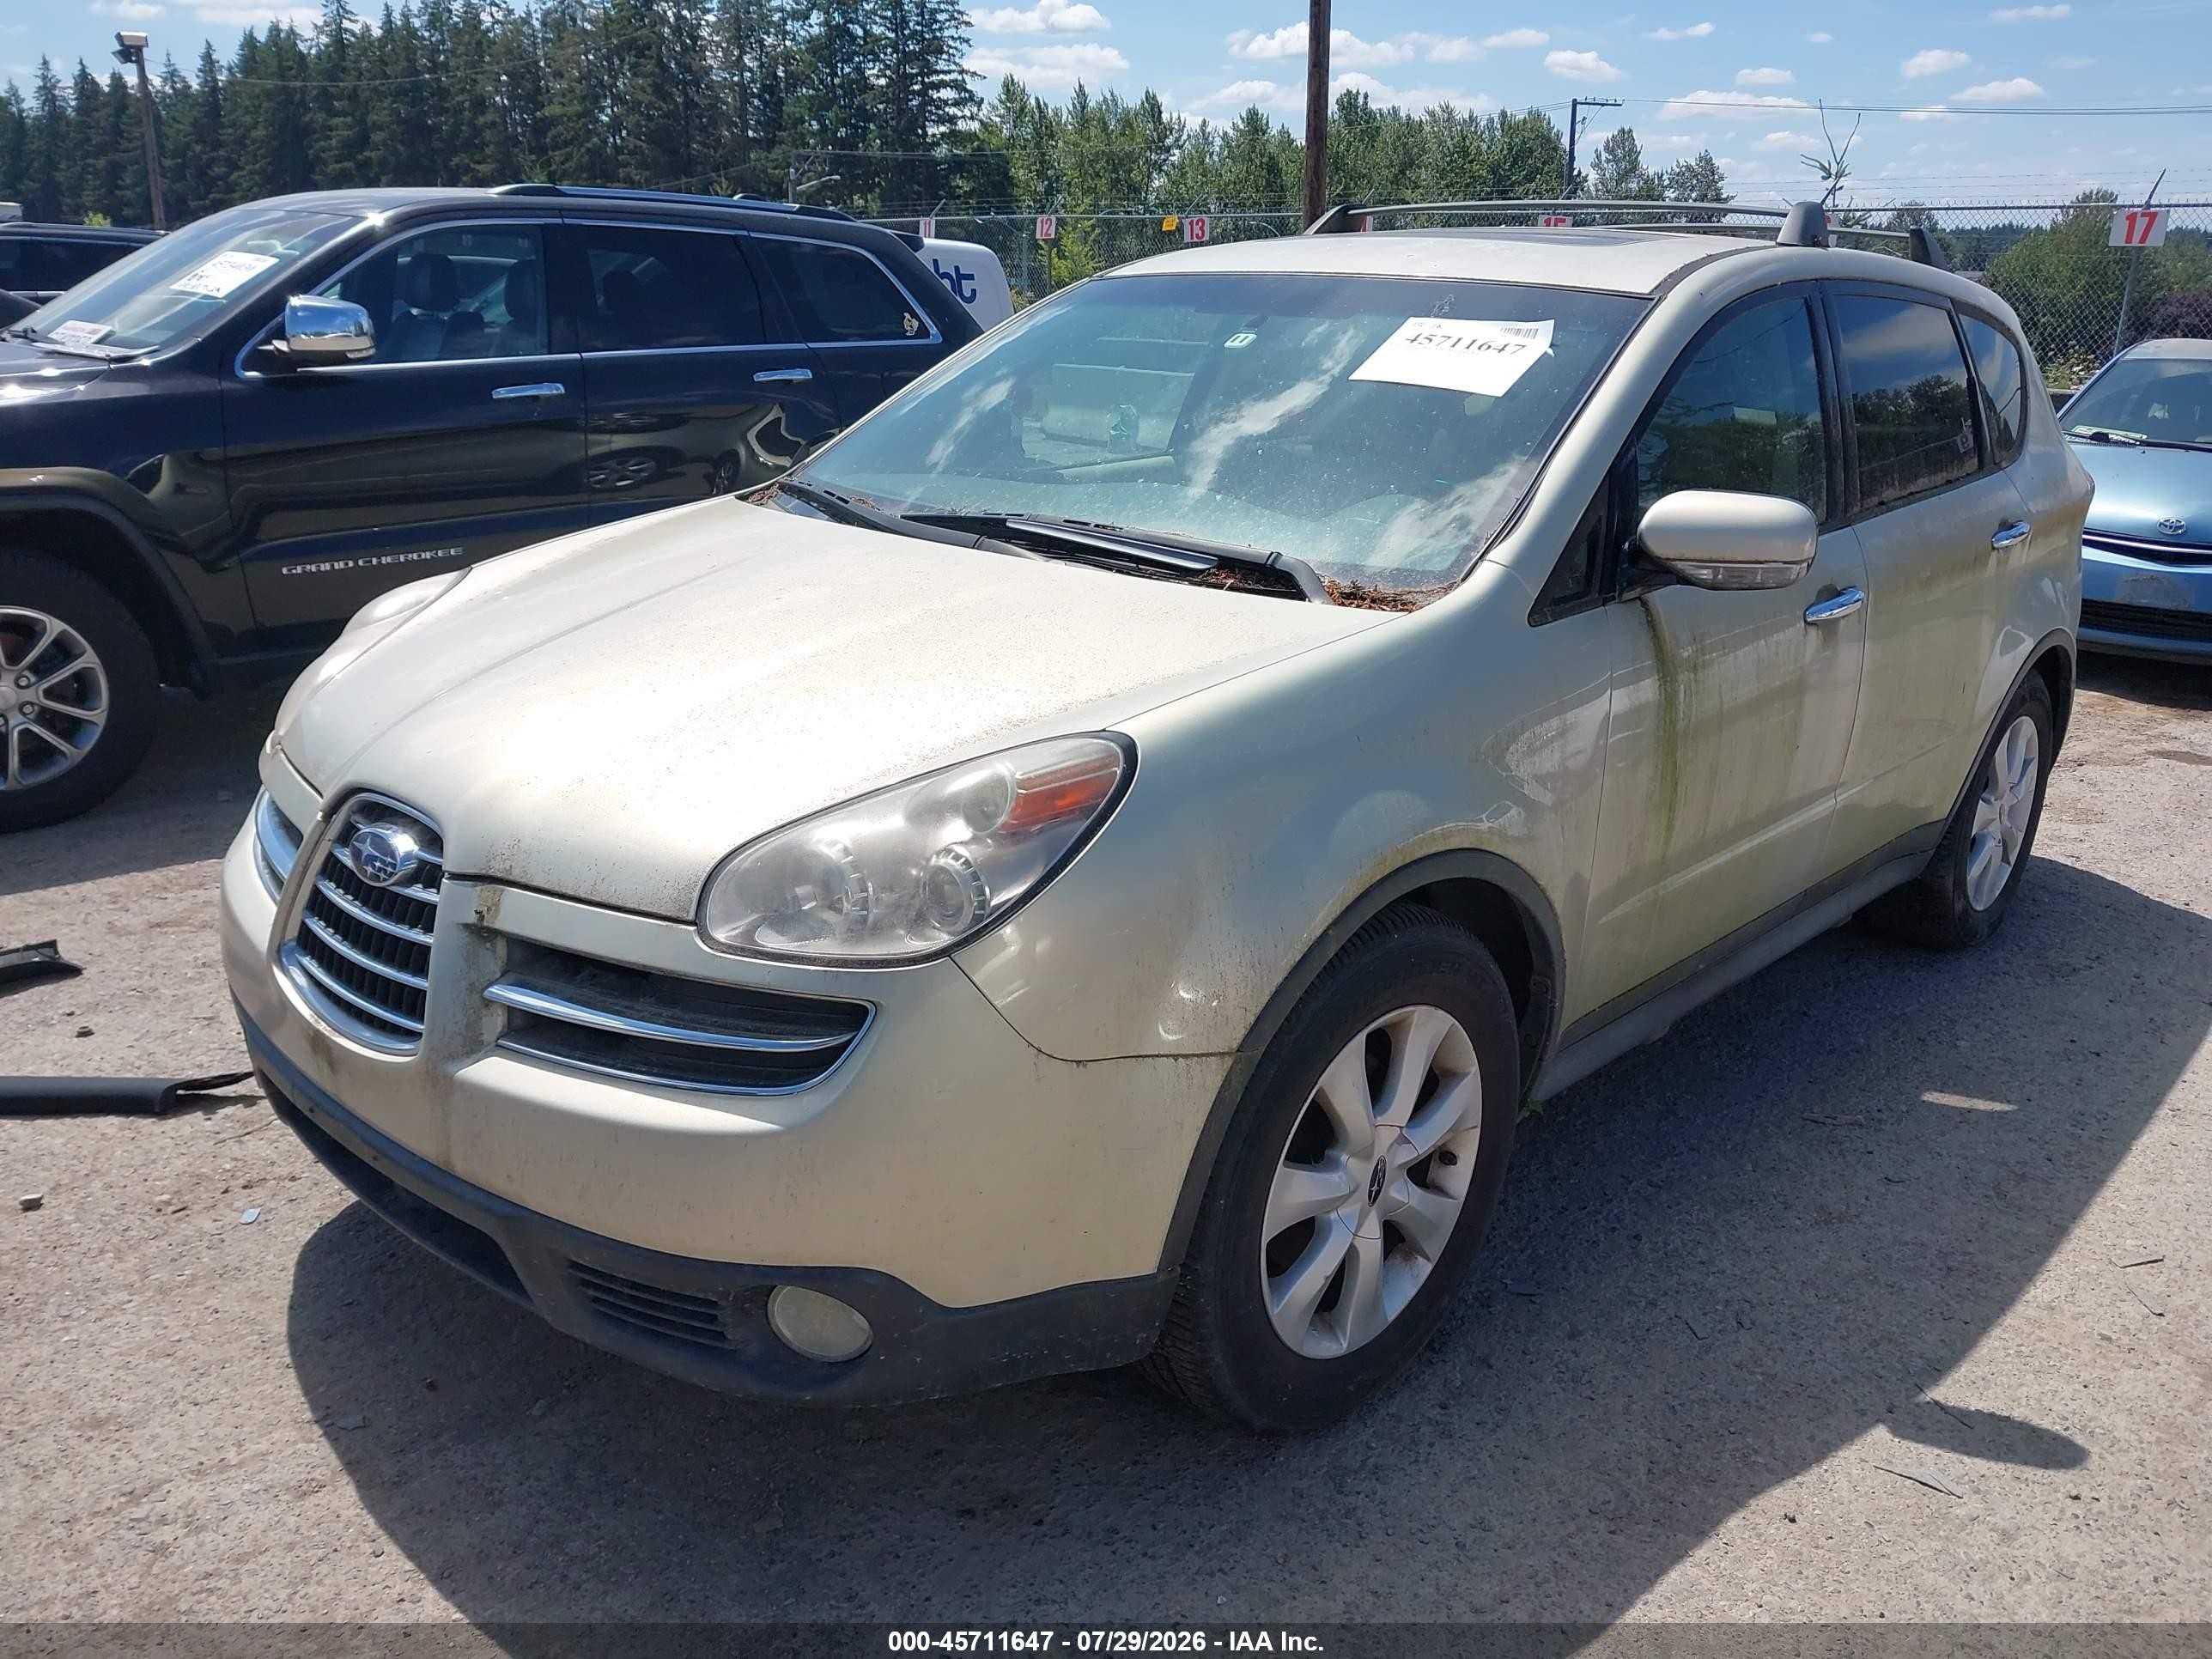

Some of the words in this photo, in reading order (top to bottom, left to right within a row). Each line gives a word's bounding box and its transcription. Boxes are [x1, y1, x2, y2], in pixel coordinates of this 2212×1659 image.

[1039, 217, 1053, 238] 12
[1188, 217, 1206, 240] 13
[2124, 211, 2159, 244] 17
[1404, 332, 1528, 356] 45711647
[281, 558, 355, 575] GRAND
[357, 546, 464, 567] CHEROKEE
